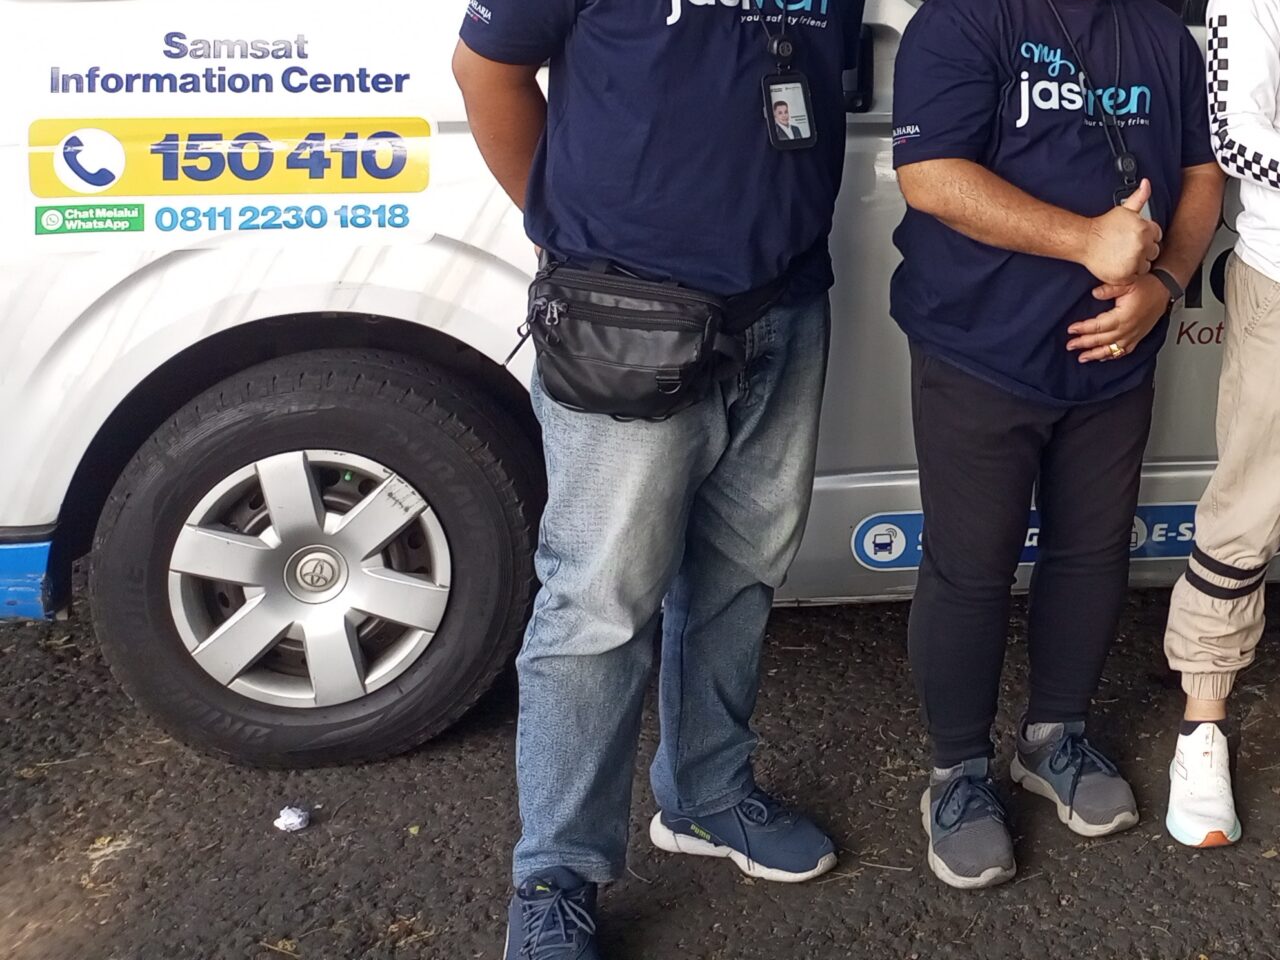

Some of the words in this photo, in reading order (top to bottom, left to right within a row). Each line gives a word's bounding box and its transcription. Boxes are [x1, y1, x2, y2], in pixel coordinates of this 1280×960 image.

[765, 14, 798, 26] safty
[799, 15, 828, 29] friend
[162, 30, 309, 60] Samsat
[1020, 41, 1076, 77] My
[49, 66, 274, 94] Information
[281, 66, 411, 94] Center
[149, 131, 275, 181] 150
[286, 130, 408, 180] 410
[65, 207, 95, 219] Chat
[95, 207, 139, 218] Melalui
[65, 219, 130, 231] WhatsApp
[154, 206, 232, 232] 0811
[239, 205, 329, 231] 2230
[334, 204, 411, 230] 1818
[1176, 320, 1225, 345] Kot
